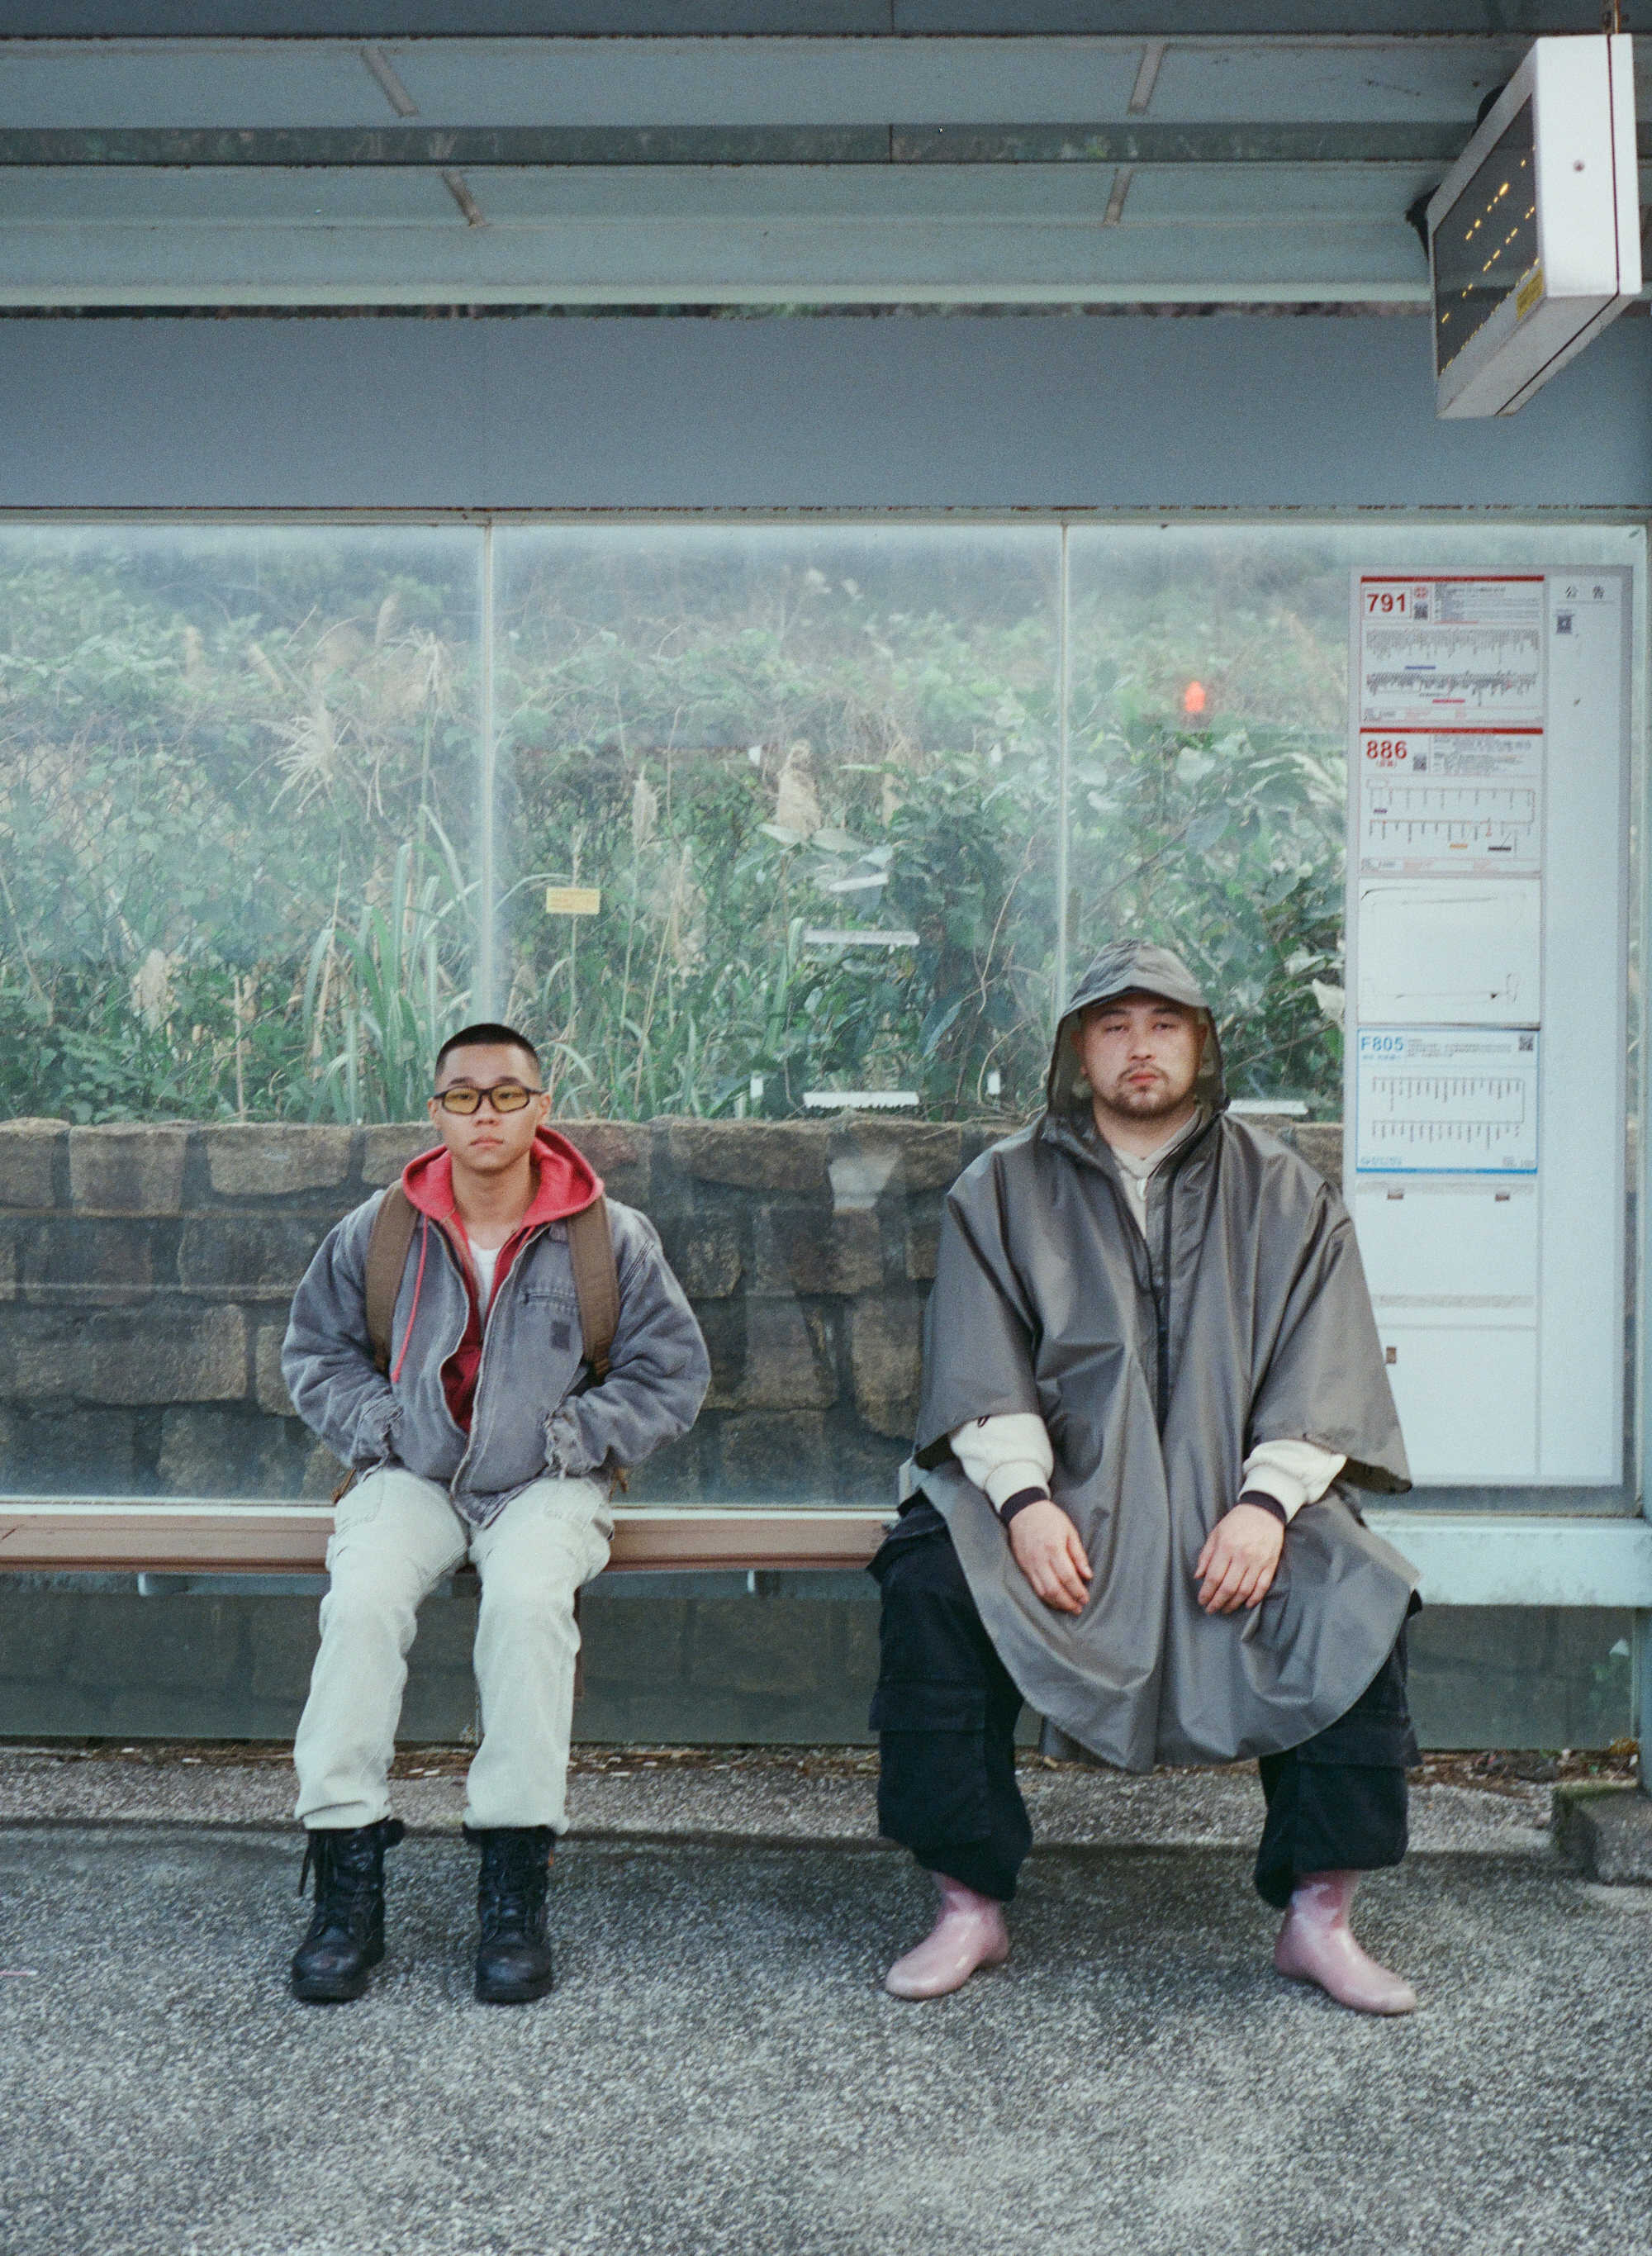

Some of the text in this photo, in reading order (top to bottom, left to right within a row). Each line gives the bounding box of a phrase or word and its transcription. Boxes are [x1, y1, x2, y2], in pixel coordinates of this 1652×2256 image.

[1367, 593, 1406, 613] 791
[1367, 740, 1408, 759] 886
[1360, 1037, 1404, 1052] F805
